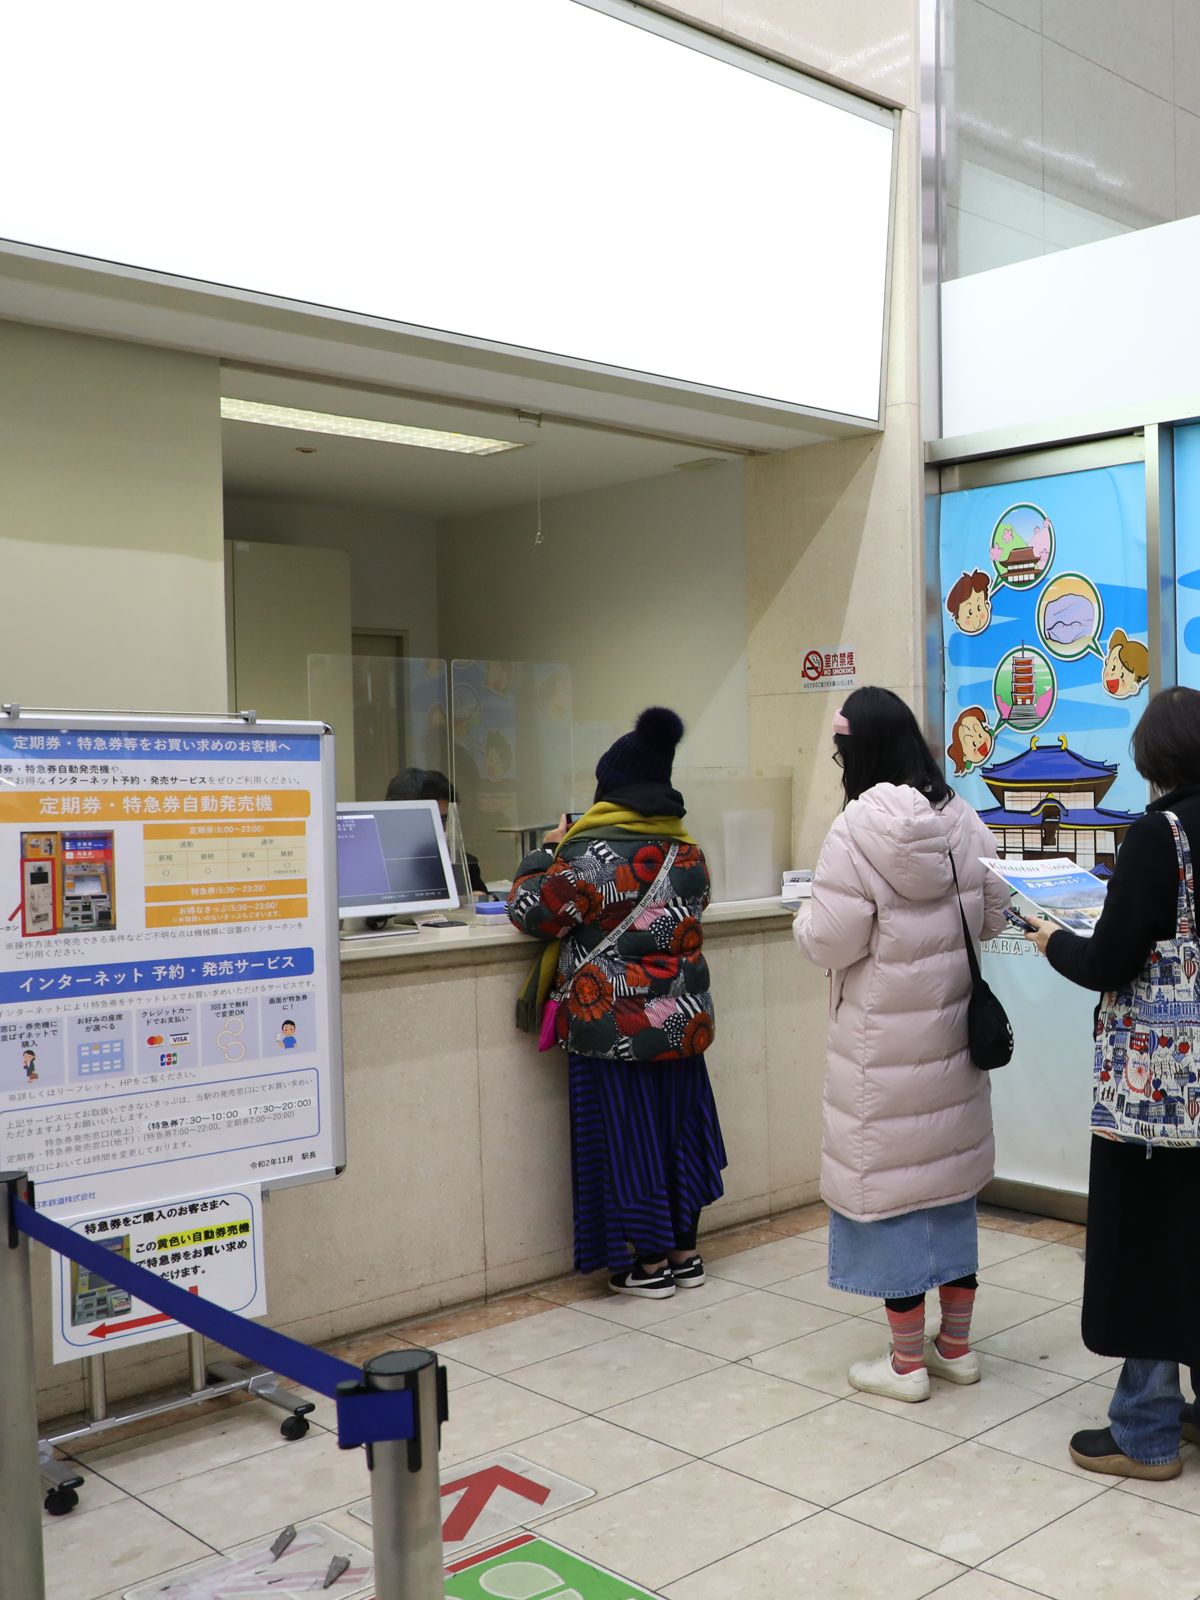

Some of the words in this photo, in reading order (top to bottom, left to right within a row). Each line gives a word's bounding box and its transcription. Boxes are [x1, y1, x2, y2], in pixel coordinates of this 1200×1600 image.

[824, 652, 854, 667] 室内禁煙
[13, 735, 290, 753] 定期券・特急券等をお買い求めのお客様へ
[0, 764, 123, 775] 券・特急券自動発売機や、
[40, 795, 273, 815] 定期券・特急券自動発売機
[19, 968, 144, 993] インターネット
[151, 955, 296, 983] 予約・発売サービス
[77, 1014, 123, 1025] お好みの座席
[85, 1023, 116, 1033] が選べる
[21, 1040, 38, 1048] 購入
[172, 1035, 188, 1043] VISA
[250, 1155, 293, 1169] 令和2年11月
[302, 1151, 316, 1160] 駅長
[84, 1199, 229, 1235] 特急券をご購入のお客さまへ
[136, 1222, 250, 1253] この黄色い自動券売機
